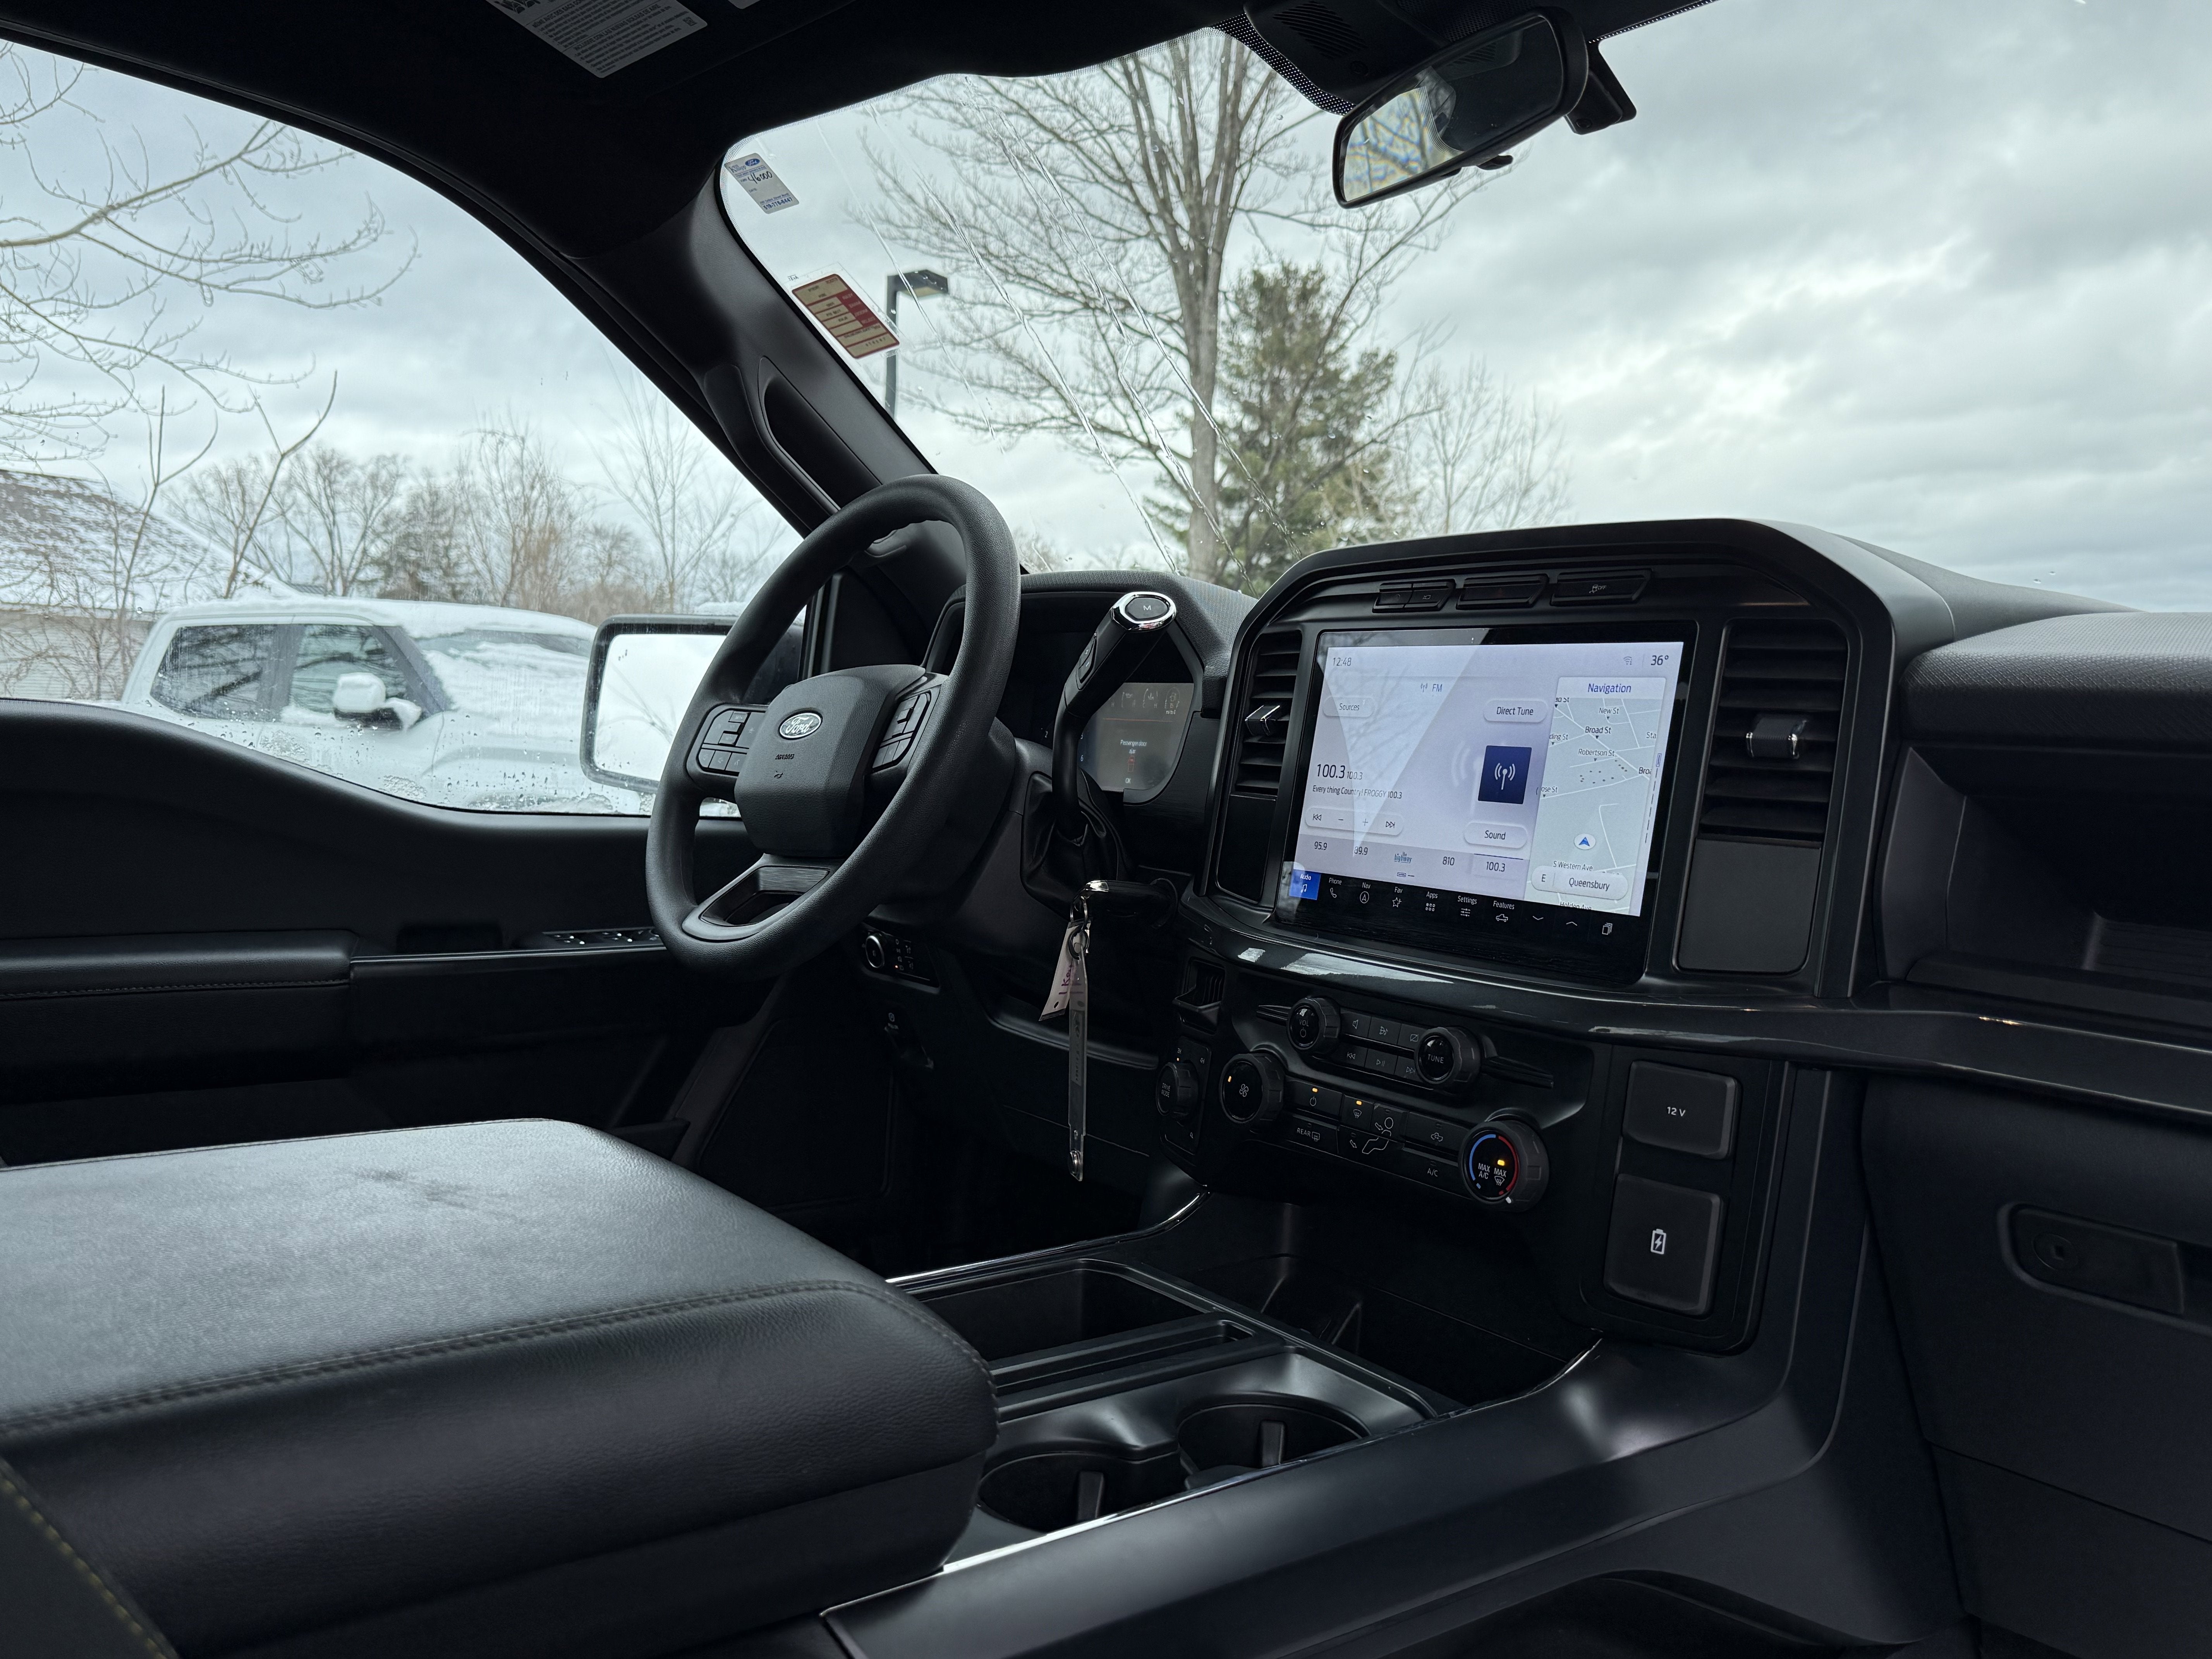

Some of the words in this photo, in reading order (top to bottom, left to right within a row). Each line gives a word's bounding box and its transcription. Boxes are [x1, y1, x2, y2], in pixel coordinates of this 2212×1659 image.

[1333, 657, 1352, 666] 12:48
[1432, 684, 1443, 692] FM
[1588, 683, 1632, 694] Navigation
[1338, 702, 1360, 711] Sources
[1496, 707, 1516, 715] Direct
[1516, 707, 1534, 716] Tune
[1578, 748, 1607, 756] Robertson
[1317, 764, 1346, 779] 100.3
[1346, 771, 1363, 780] 100.3
[1312, 785, 1326, 793] Every
[1327, 786, 1341, 795] thing
[1341, 787, 1364, 797] Country!
[1364, 789, 1386, 798] FROGGY
[1388, 791, 1402, 799] 100.3
[1484, 830, 1506, 840] Sound
[1314, 841, 1328, 850] 95.9
[1354, 846, 1368, 855] 89.9
[1443, 856, 1455, 866] 810
[1486, 861, 1506, 872] 100.3
[1558, 861, 1581, 870] Western
[1329, 877, 1342, 885] Phone
[1541, 874, 1546, 882] E
[1569, 878, 1610, 891] Queensbury
[1426, 891, 1438, 899] Apps
[1457, 895, 1477, 905] Settings
[1493, 900, 1515, 910] Features
[1299, 1019, 1309, 1027] VOL
[1428, 1054, 1444, 1064] TUNE
[1667, 1106, 1677, 1115] 12
[1679, 1108, 1686, 1117] V
[1297, 1127, 1311, 1137] REAR
[1427, 1168, 1438, 1177] A/C
[1478, 1163, 1491, 1173] MAX
[1494, 1167, 1507, 1178] MAX
[1478, 1171, 1489, 1180] A/C
